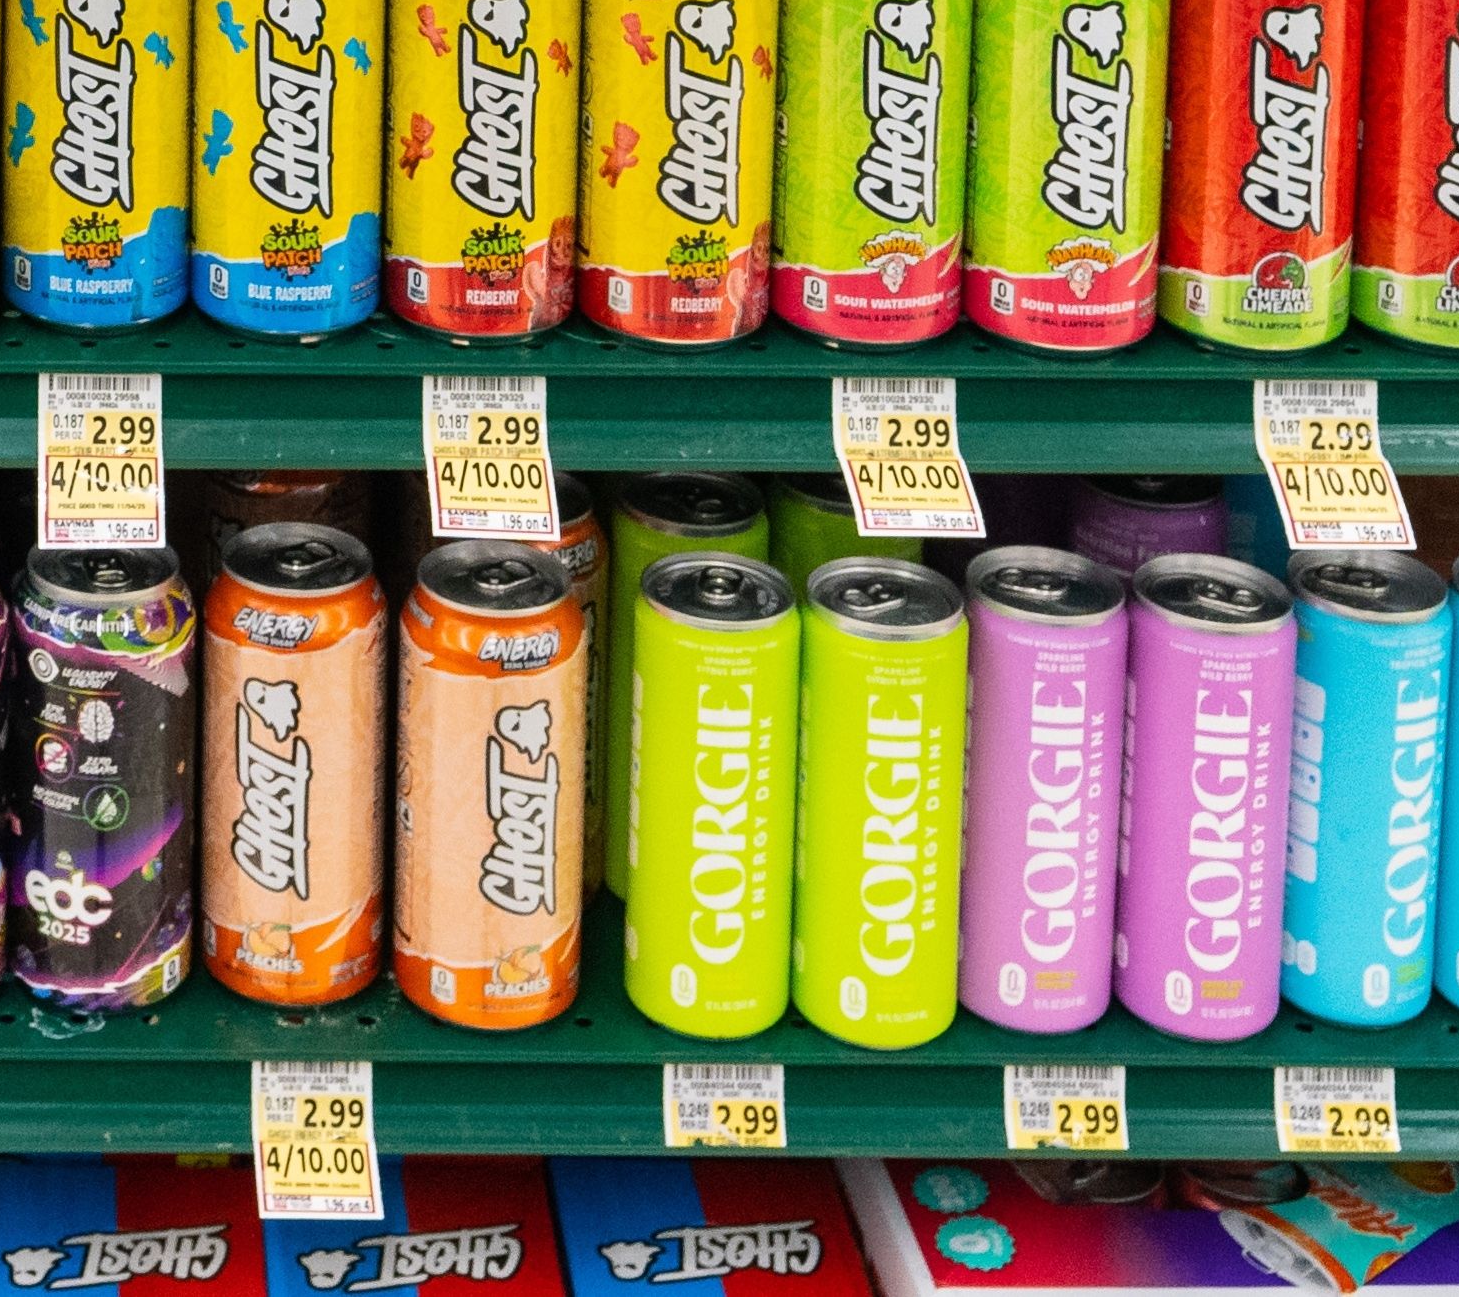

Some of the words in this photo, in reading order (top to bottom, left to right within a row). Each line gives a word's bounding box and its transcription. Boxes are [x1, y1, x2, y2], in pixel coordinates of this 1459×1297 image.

[52, 25, 135, 210] GHOST
[833, 294, 869, 307] SOUR
[92, 416, 156, 445] 2.99
[52, 461, 154, 492] 4/10.00
[756, 716, 773, 803] DRINK
[688, 684, 754, 964] GORGIE
[26, 872, 112, 927] edc
[750, 829, 770, 923] ENERGY
[39, 917, 90, 944] 2025
